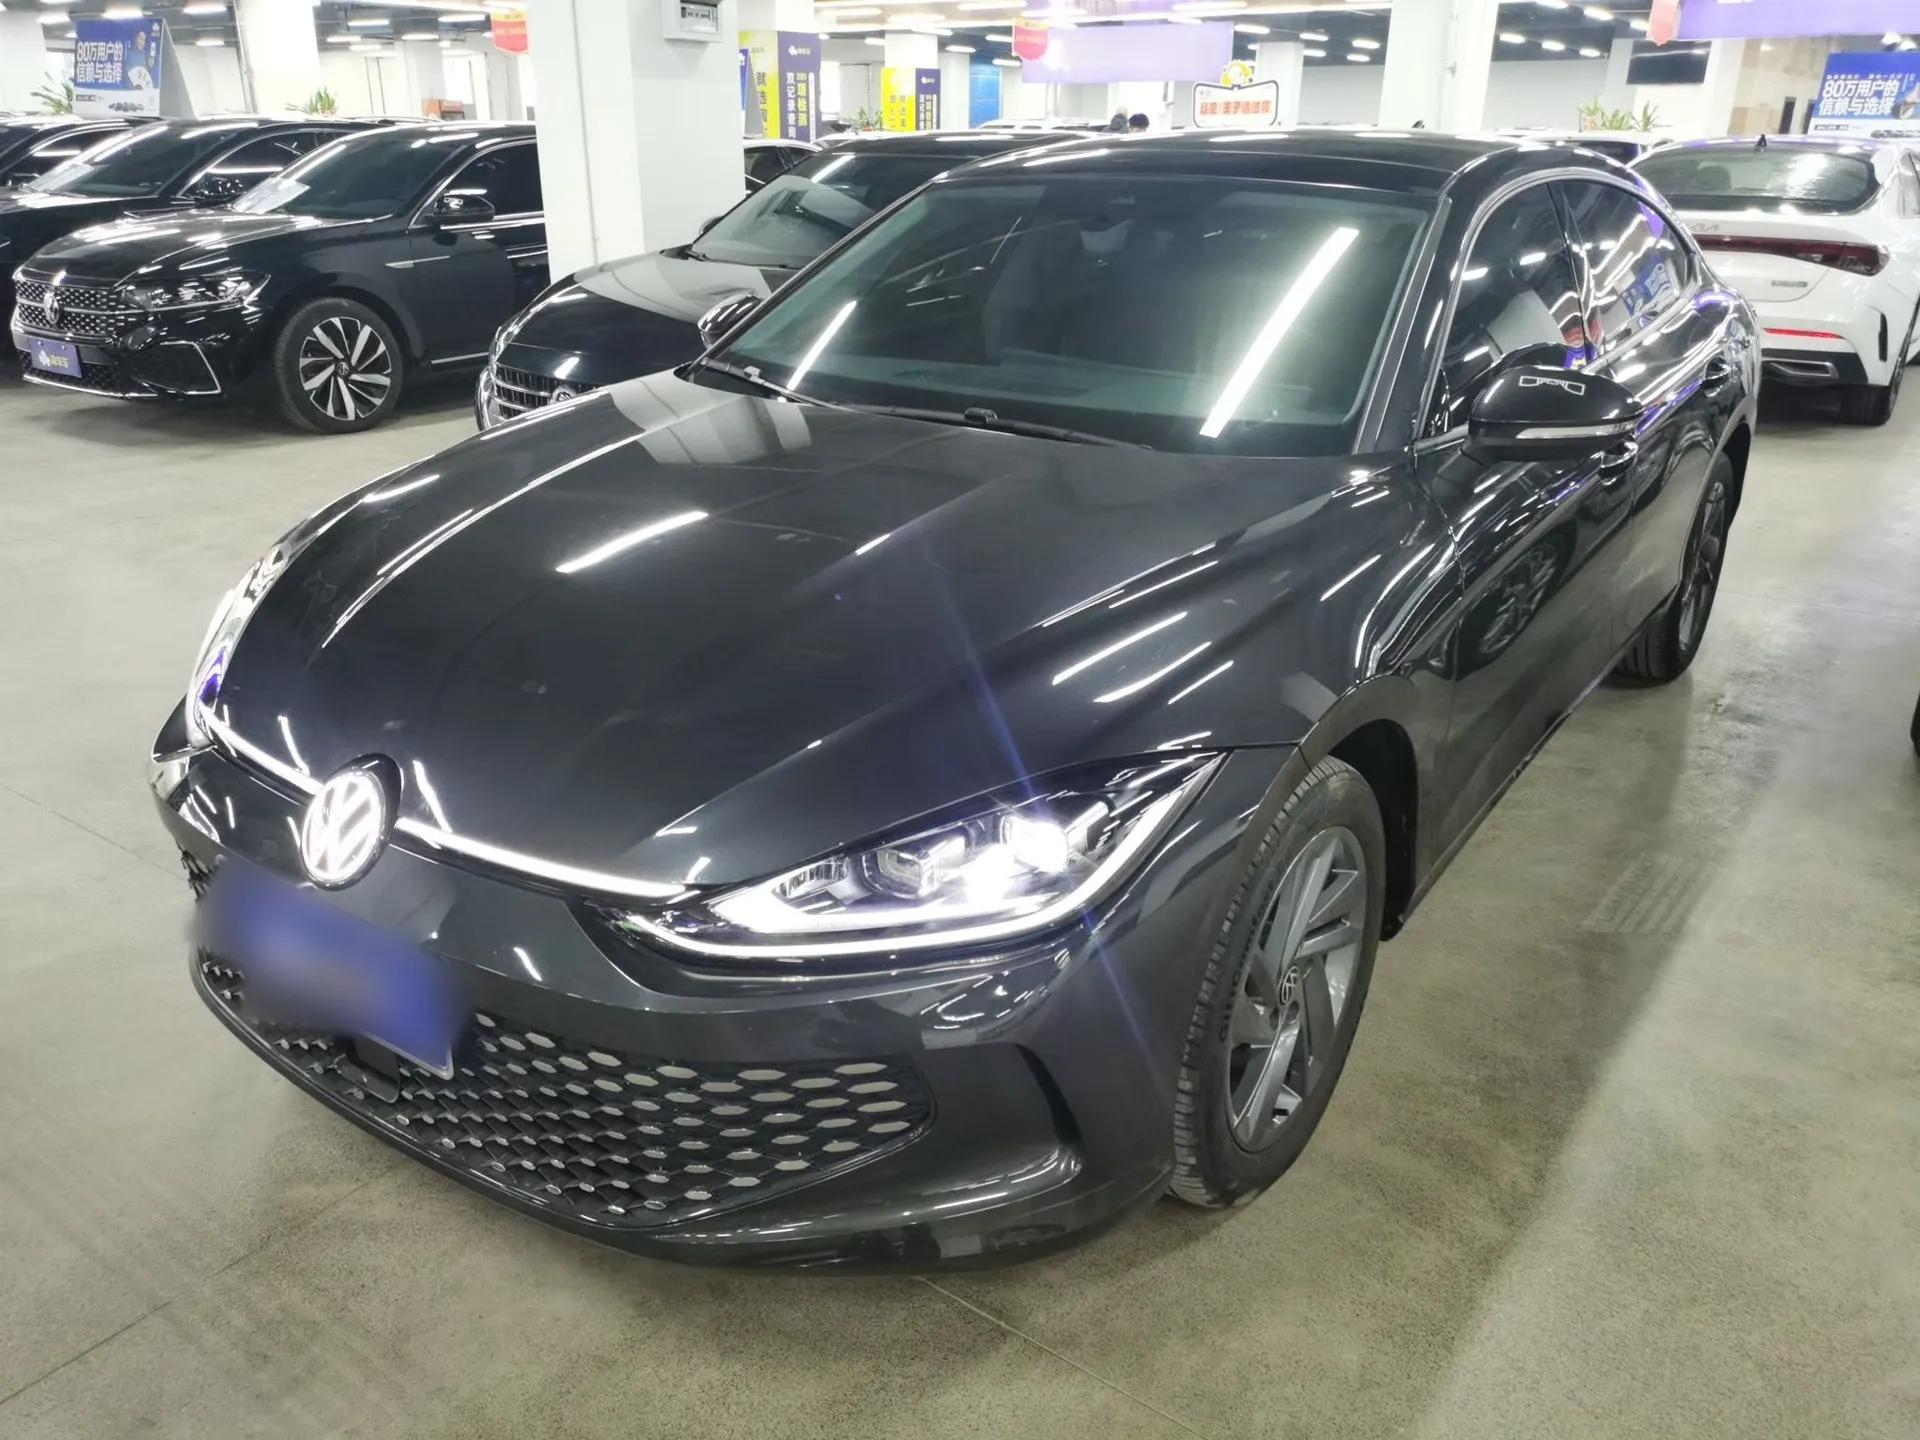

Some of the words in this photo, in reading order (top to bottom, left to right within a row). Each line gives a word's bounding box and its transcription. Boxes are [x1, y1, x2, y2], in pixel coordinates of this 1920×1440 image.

[76, 41, 124, 62] 80万用户的
[76, 62, 123, 84] 信赖与选择
[1822, 79, 1900, 98] 80万用户的
[1818, 97, 1896, 116] 信赖与选择
